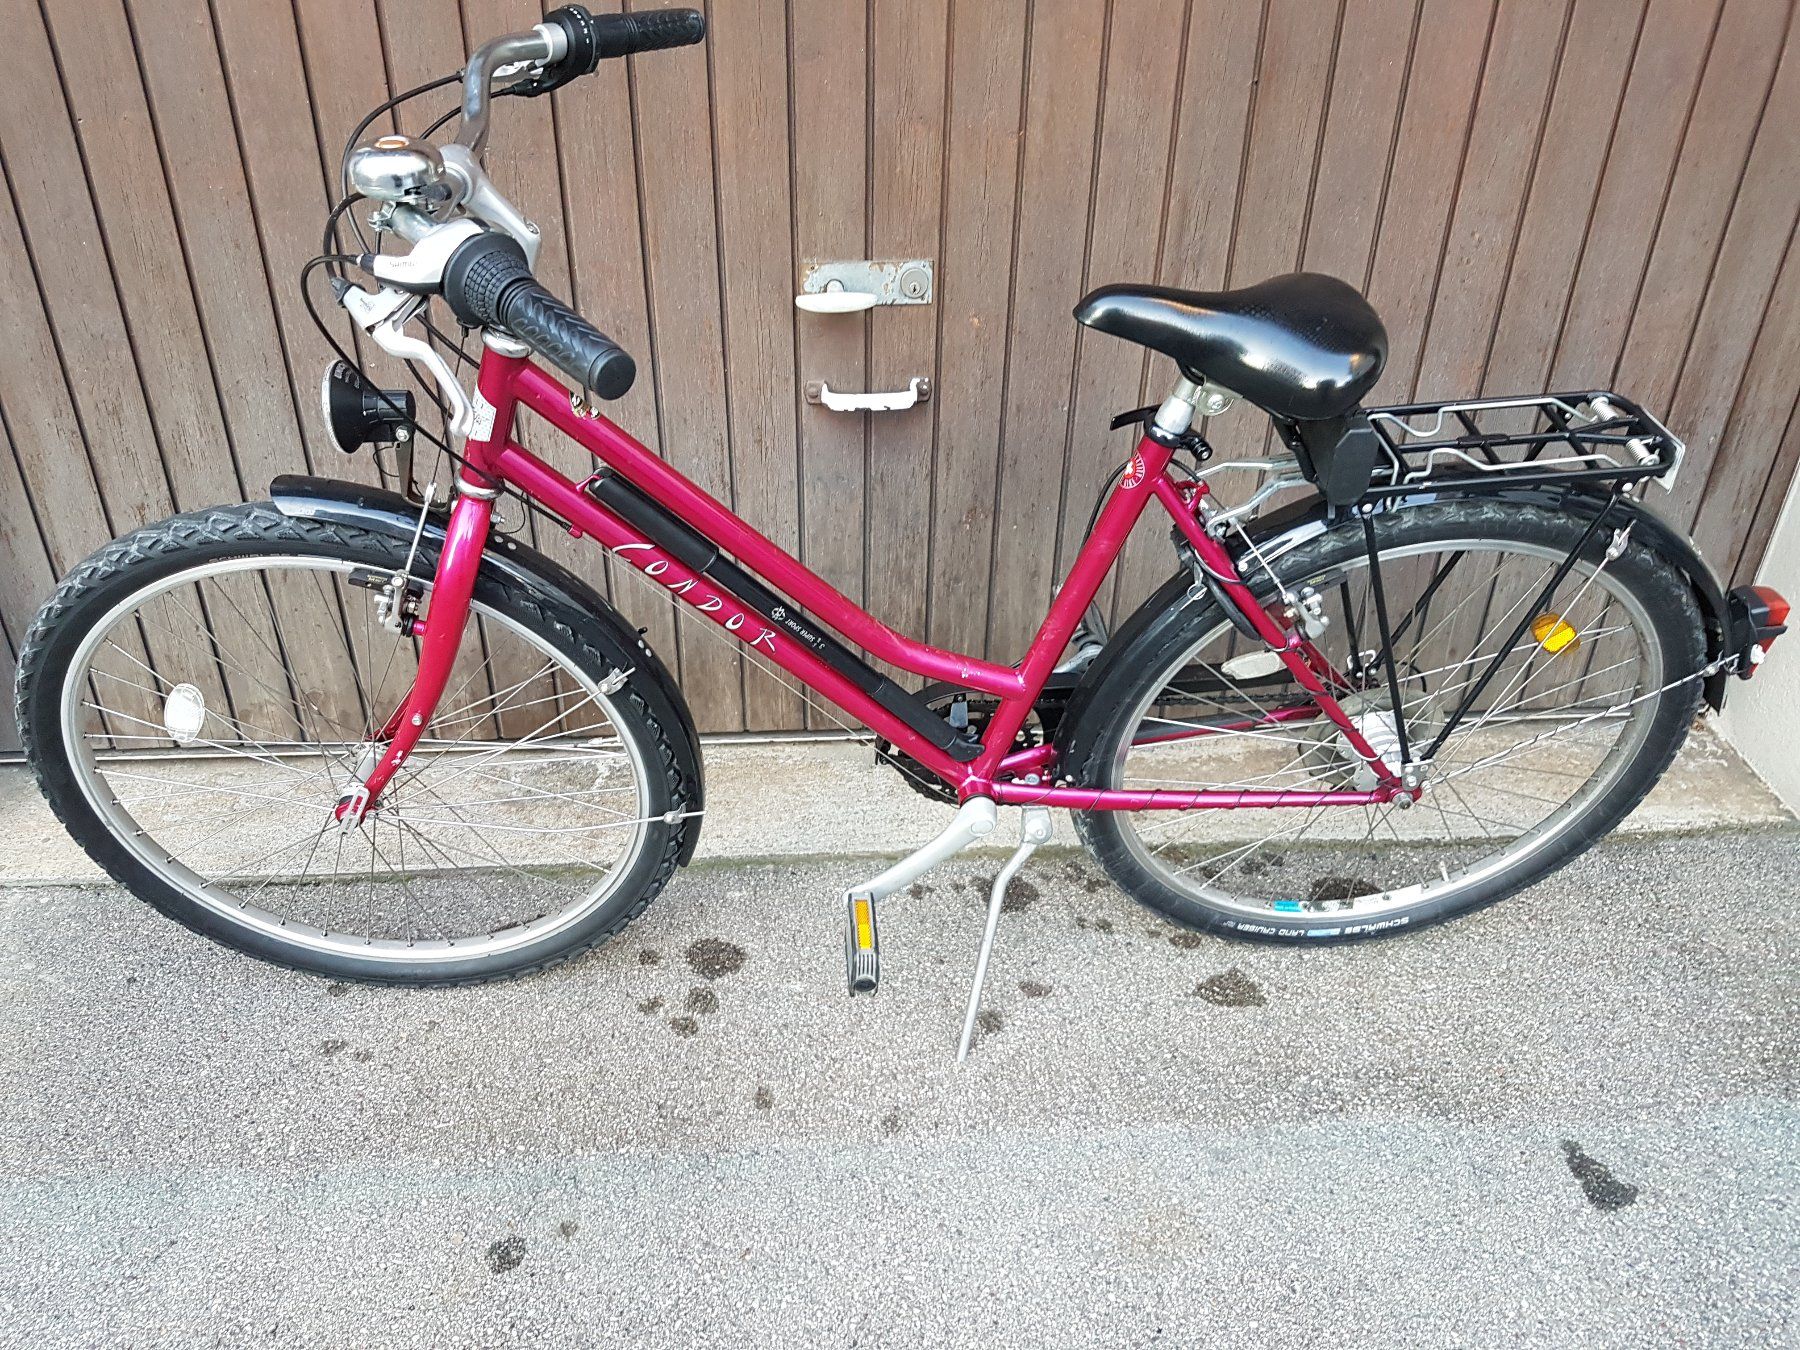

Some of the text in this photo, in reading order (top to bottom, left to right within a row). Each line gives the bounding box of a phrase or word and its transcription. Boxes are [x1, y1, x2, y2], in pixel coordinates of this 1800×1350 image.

[611, 543, 776, 652] CONDOR
[785, 619, 802, 632] SPORT
[799, 629, 816, 643] SUPER
[1278, 928, 1305, 937] LAND
[1344, 916, 1410, 935] SCHWALBE
